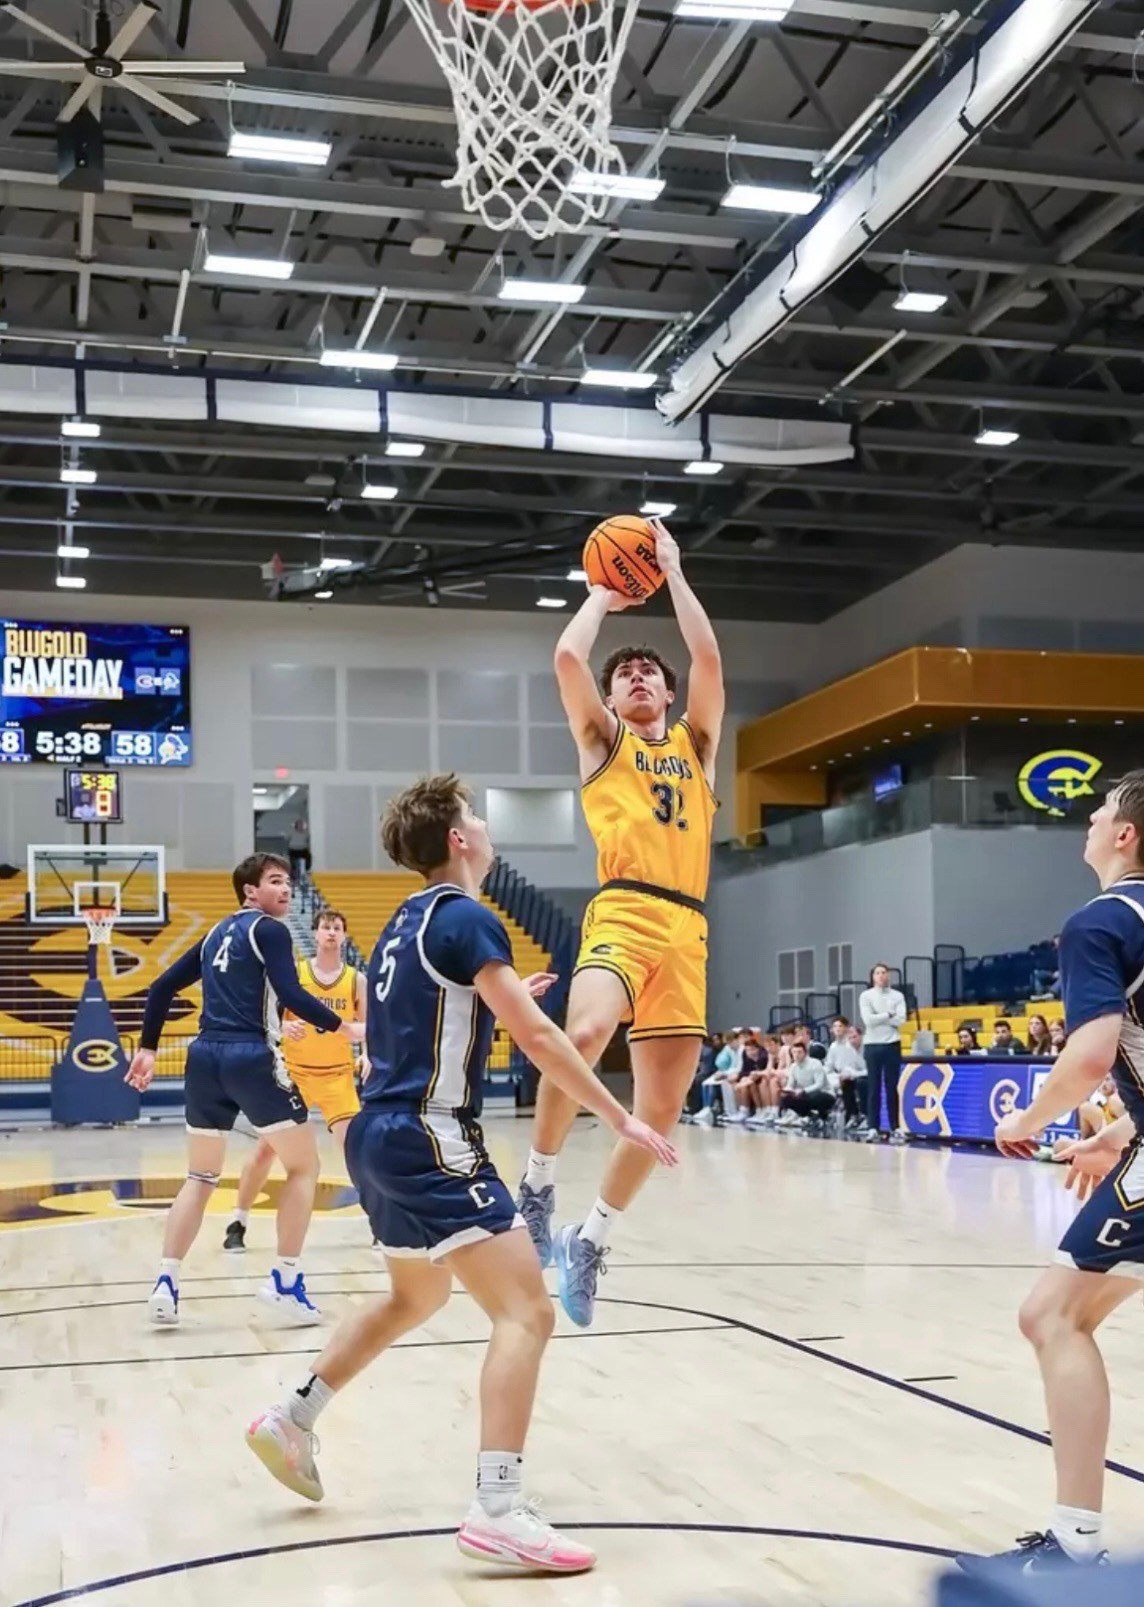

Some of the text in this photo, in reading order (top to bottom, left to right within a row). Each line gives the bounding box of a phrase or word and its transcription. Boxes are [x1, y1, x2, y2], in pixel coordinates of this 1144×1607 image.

[5, 629, 87, 658] BLUGOLD
[2, 656, 123, 699] GAMEDAY
[36, 731, 101, 755] 5:38
[116, 733, 152, 756] 58
[212, 936, 234, 973] 4
[375, 936, 401, 1003] 5
[468, 1182, 496, 1209] C
[1095, 1217, 1131, 1247] C
